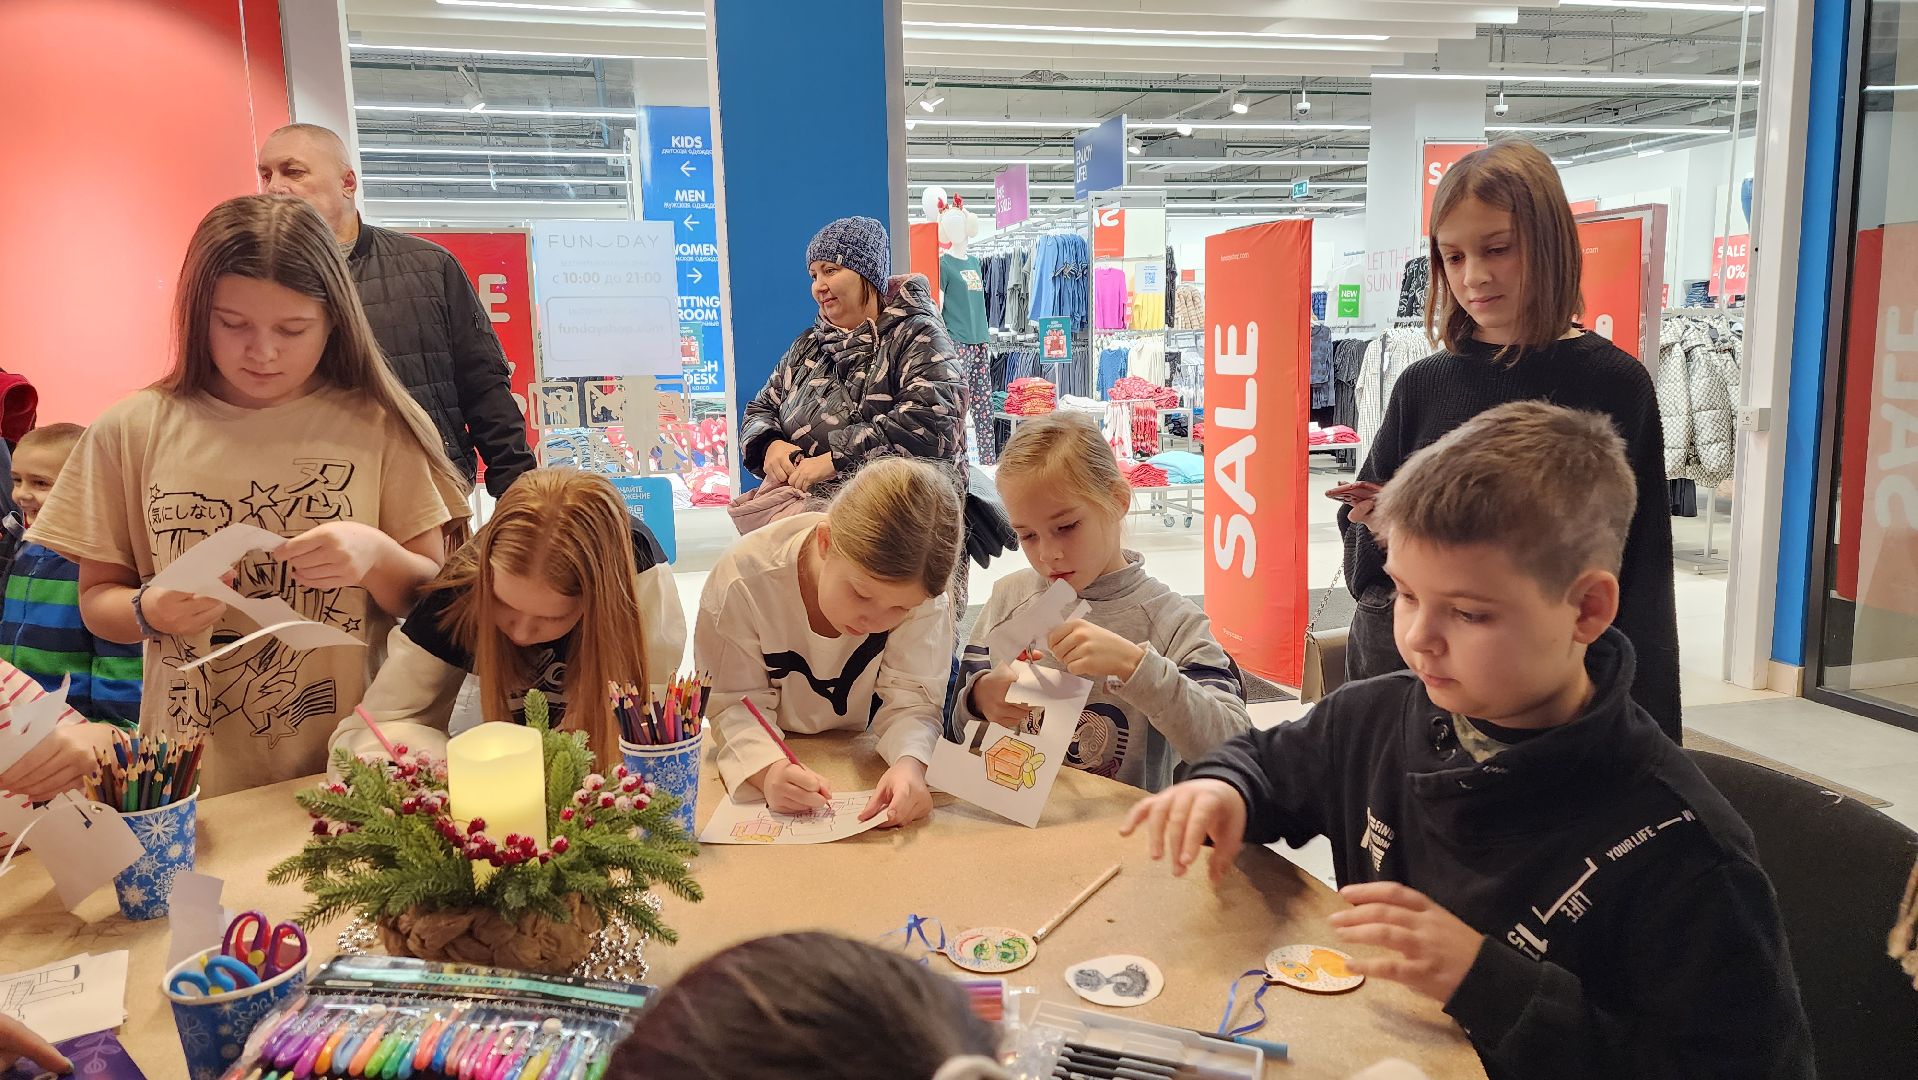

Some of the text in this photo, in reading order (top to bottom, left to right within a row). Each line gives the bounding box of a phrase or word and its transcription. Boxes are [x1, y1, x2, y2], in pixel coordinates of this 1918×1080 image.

[671, 135, 703, 149] KIDS
[1075, 143, 1093, 166] ENJOY
[675, 189, 706, 202] MEN
[548, 233, 660, 249] FUN DAY
[1717, 244, 1746, 259] SALE
[1367, 250, 1384, 271] LET
[563, 272, 601, 285] 10:00
[625, 271, 662, 285] 21:00
[1366, 271, 1392, 293] SUN
[1341, 289, 1358, 298] NEW
[677, 295, 720, 308] ITTING
[678, 308, 719, 321] ROOM
[683, 372, 719, 385] DESK
[1213, 320, 1259, 579] SALE
[151, 504, 225, 525] 気にしない
[1606, 825, 1657, 862] YOUR LIFE
[1559, 890, 1593, 924] LIFE
